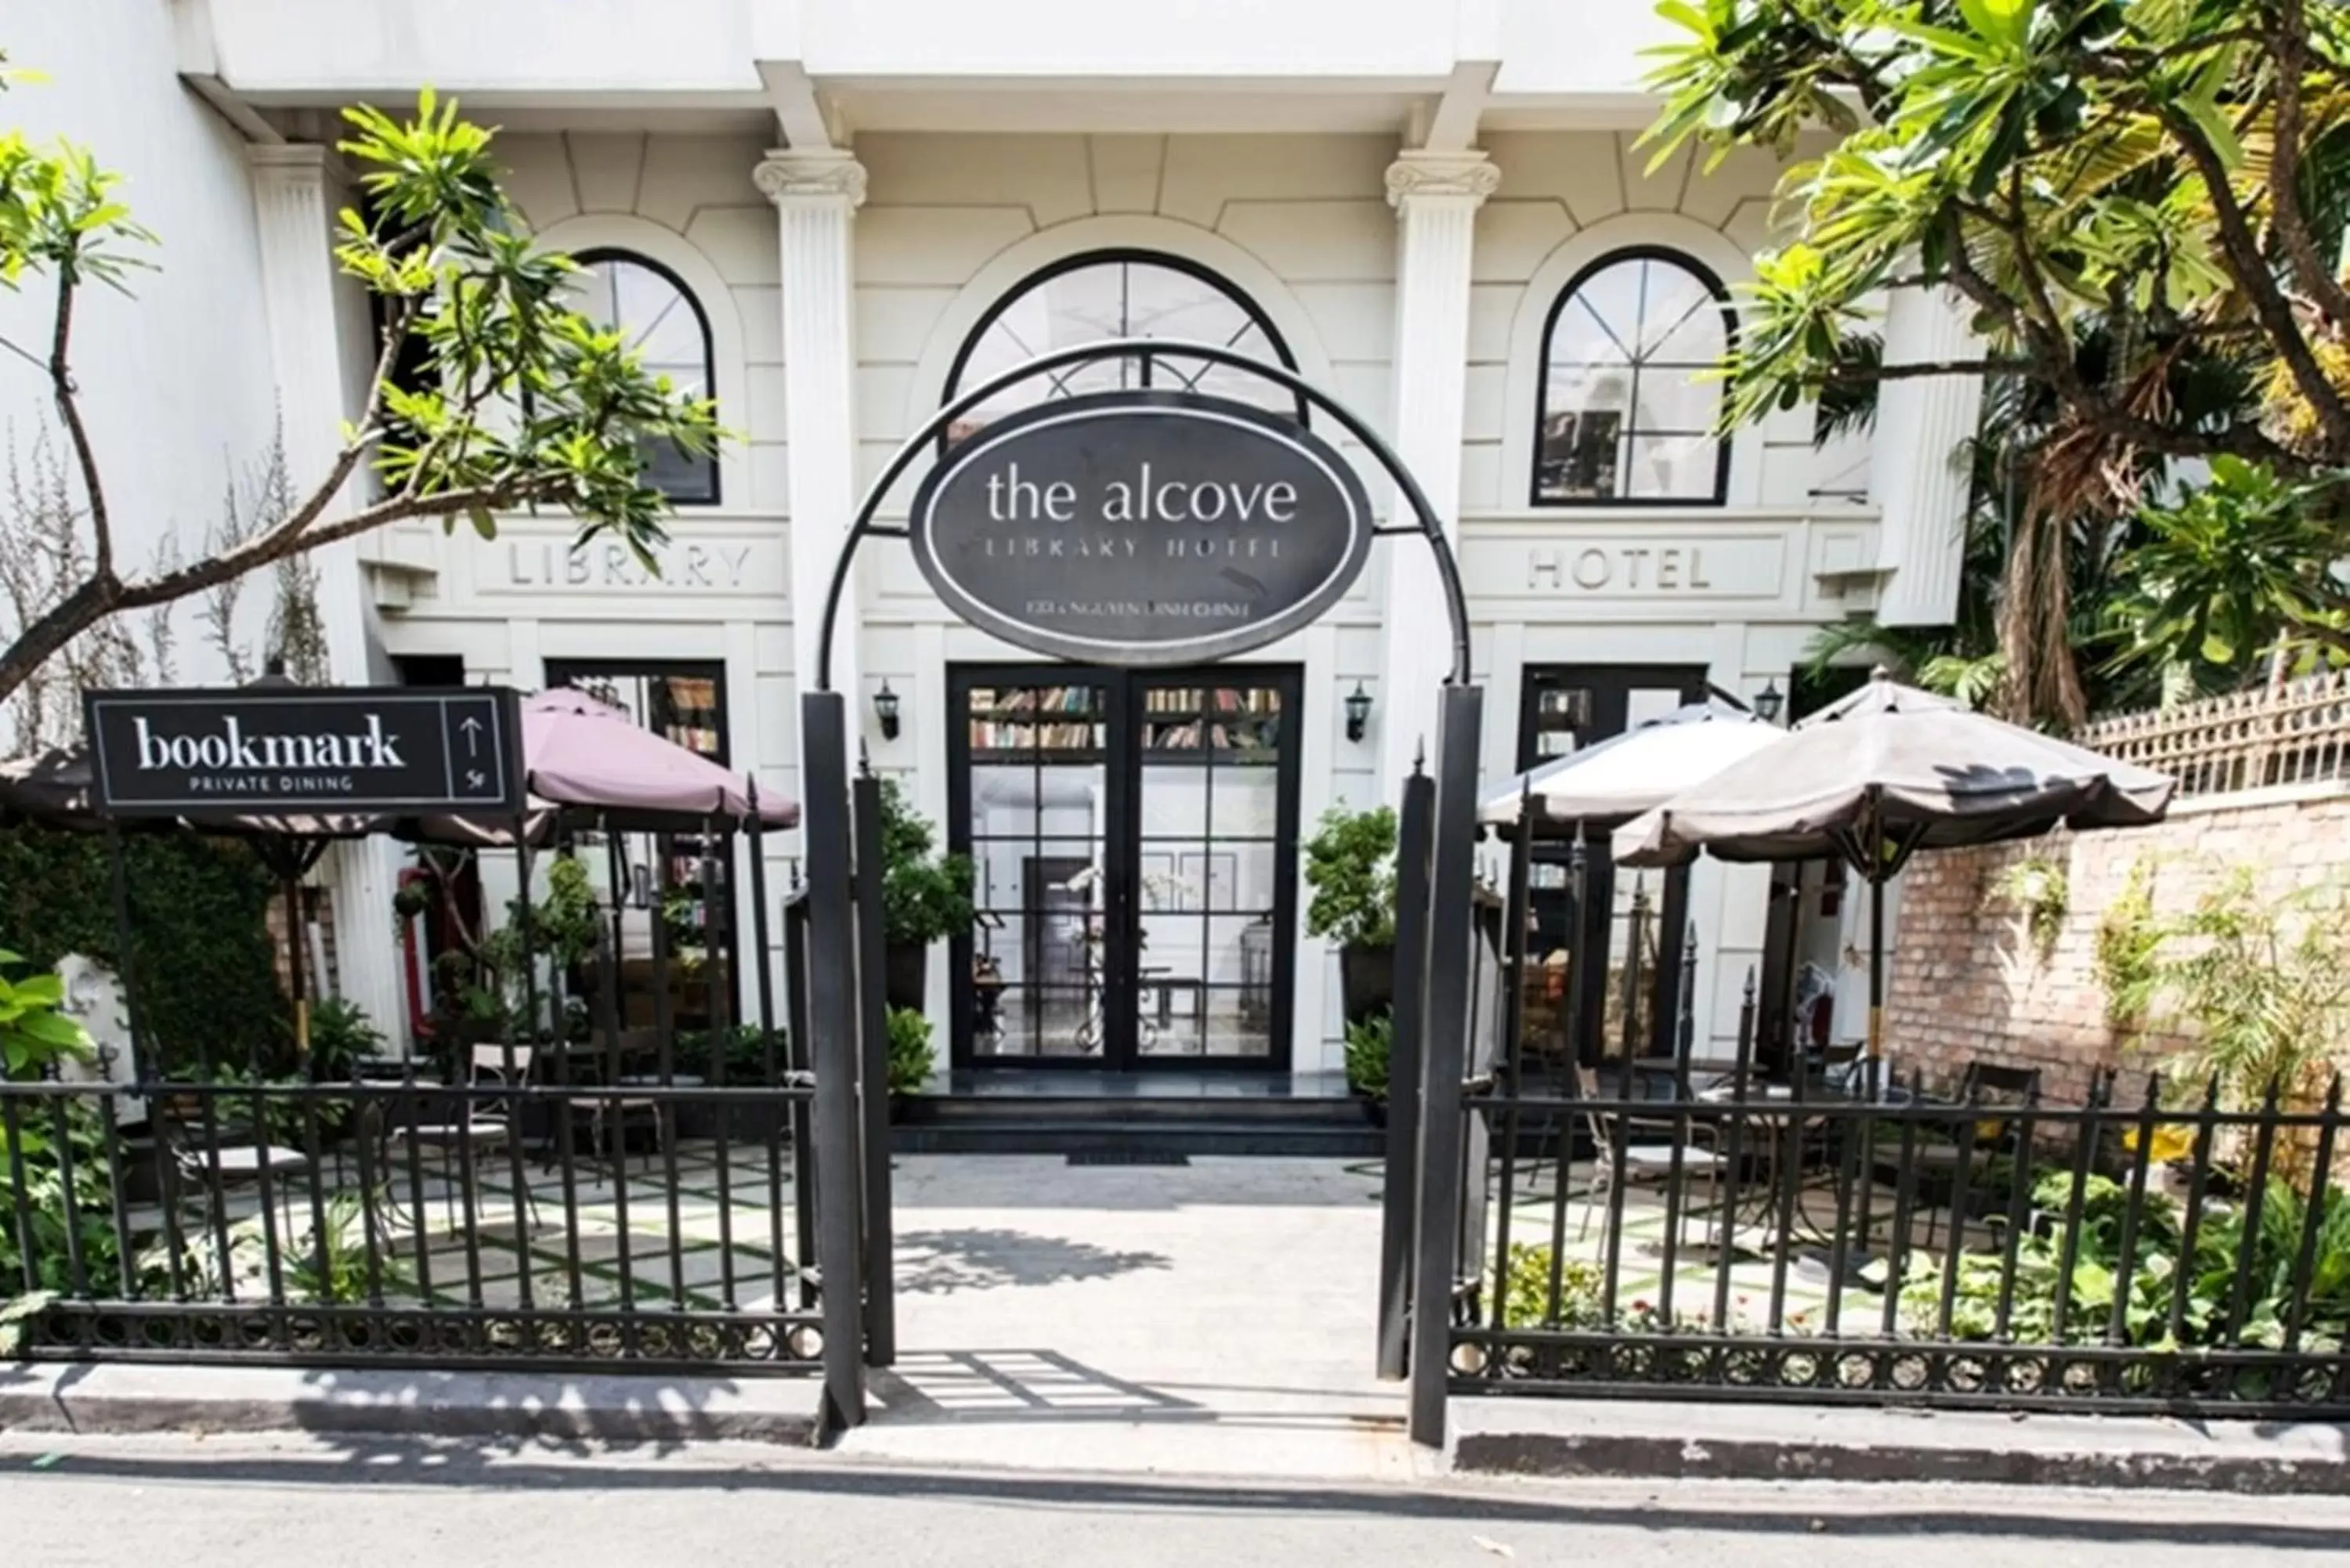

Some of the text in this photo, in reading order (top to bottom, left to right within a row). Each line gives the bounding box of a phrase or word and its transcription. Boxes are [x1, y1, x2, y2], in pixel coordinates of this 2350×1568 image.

[987, 462, 1298, 522] the alcove
[985, 537, 1281, 558] LIBRARY HOTEL
[1528, 547, 1710, 590] HOTEL
[132, 714, 406, 769] bookmark
[189, 775, 352, 791] PRIVATE DINING
